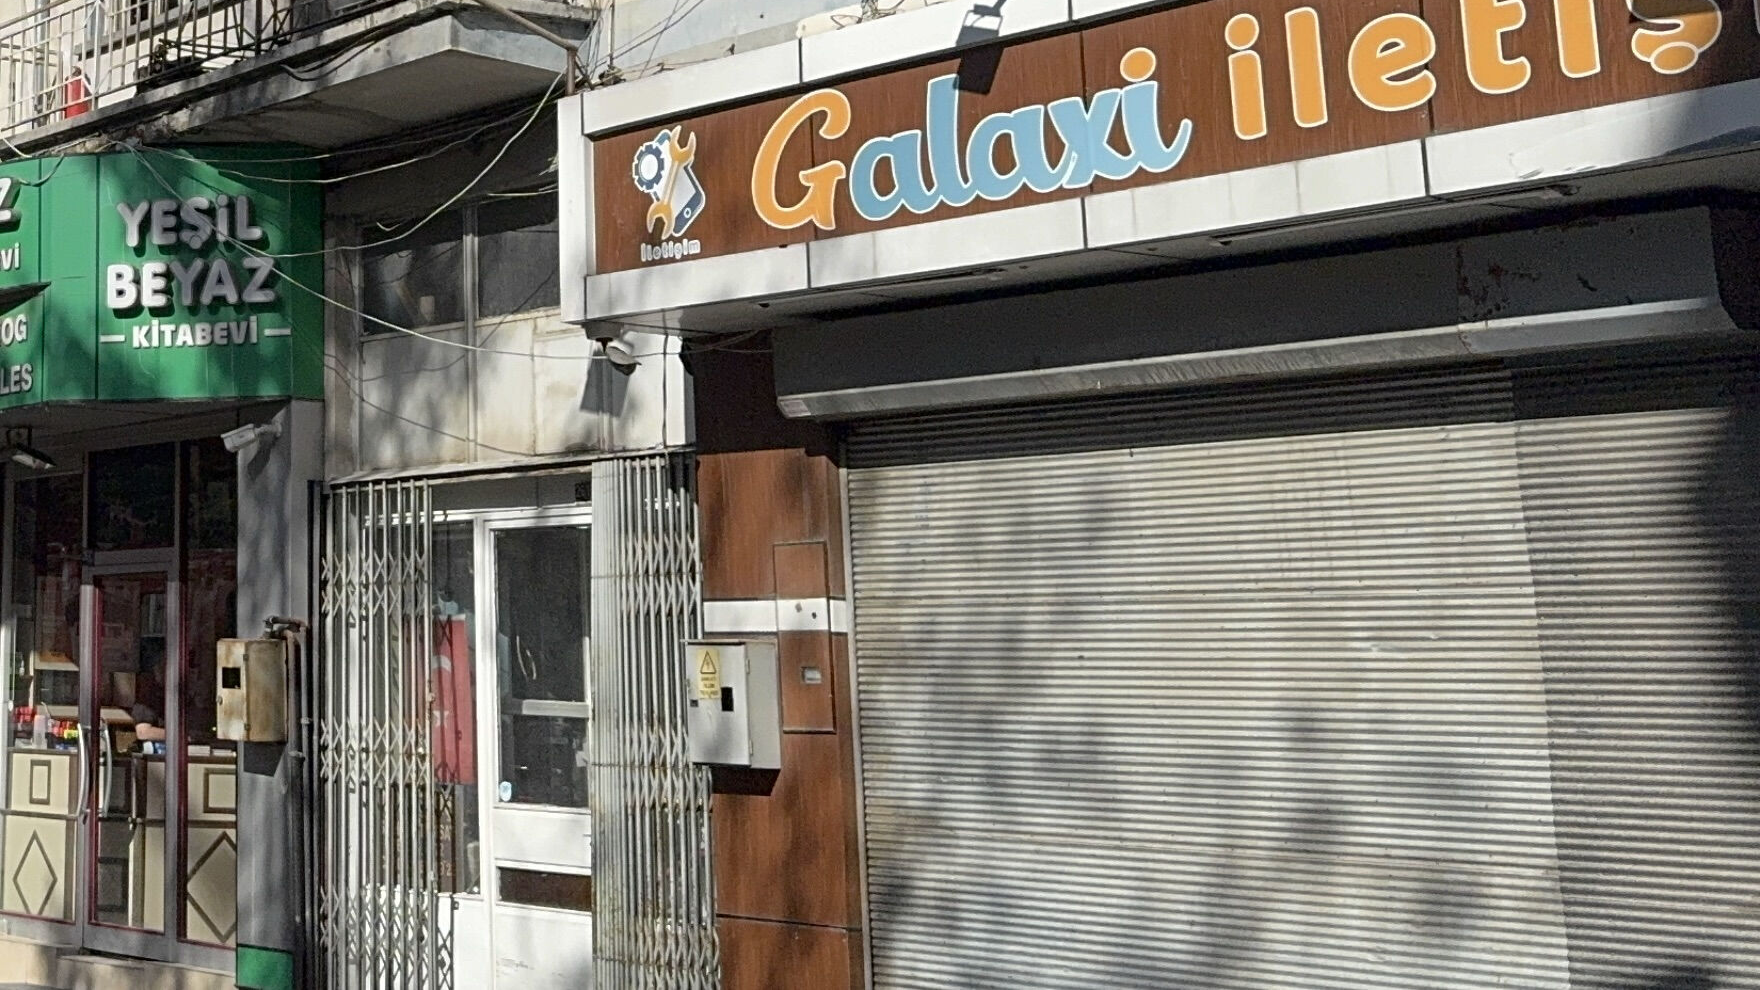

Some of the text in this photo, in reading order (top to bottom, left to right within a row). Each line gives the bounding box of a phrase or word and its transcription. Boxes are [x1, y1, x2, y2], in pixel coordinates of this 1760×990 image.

[752, 48, 1193, 231] Galaxi
[116, 194, 263, 249] YEŞİL
[107, 257, 276, 309] BEYAZ
[132, 316, 258, 348] KİTABEVİ
